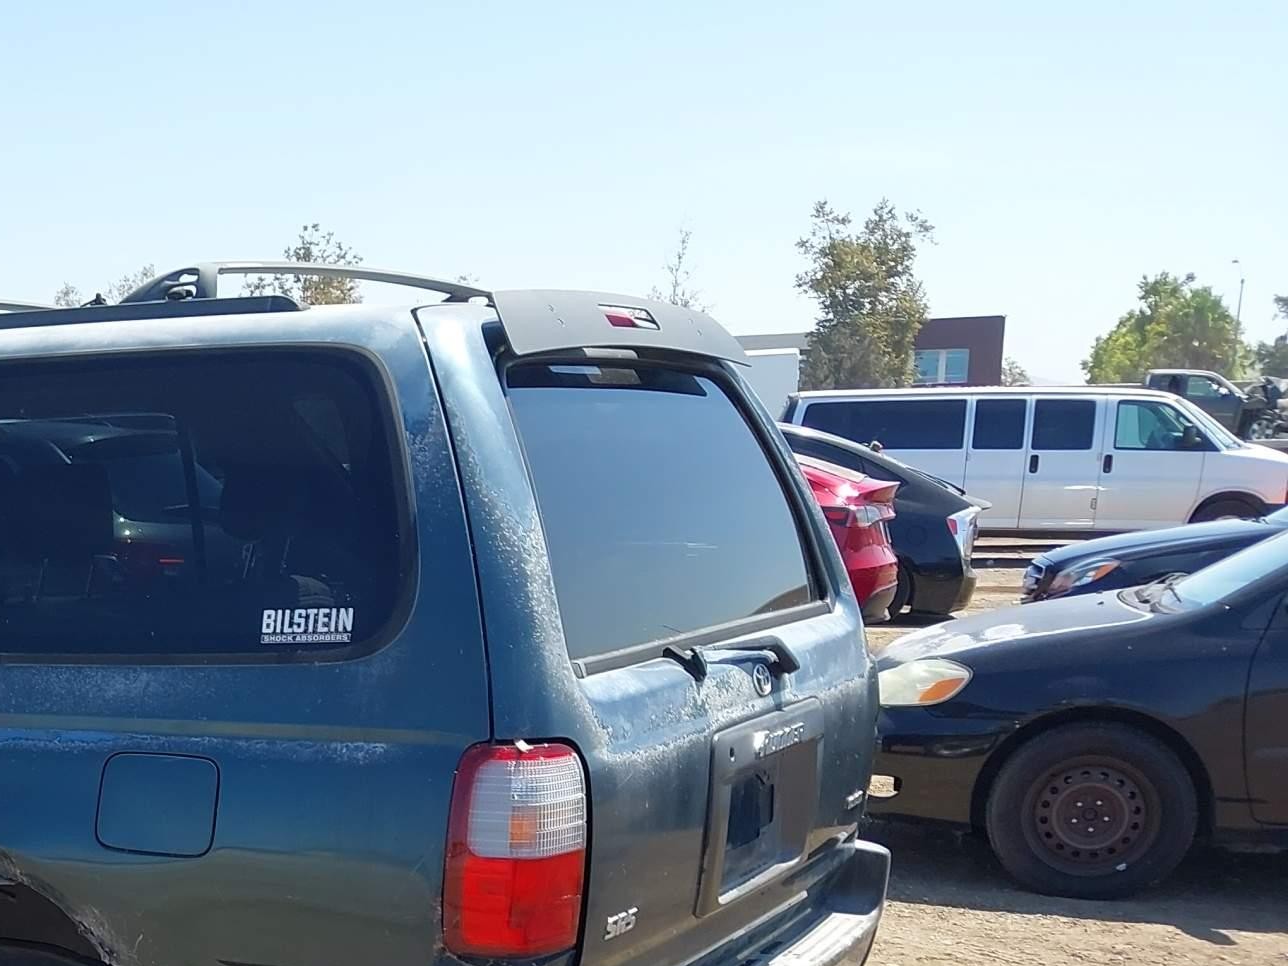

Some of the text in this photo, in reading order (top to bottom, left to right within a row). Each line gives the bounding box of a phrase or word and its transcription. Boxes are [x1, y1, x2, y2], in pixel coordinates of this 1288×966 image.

[262, 607, 354, 633] BILSTEIN
[264, 633, 348, 642] SHOCK ABSORBERS
